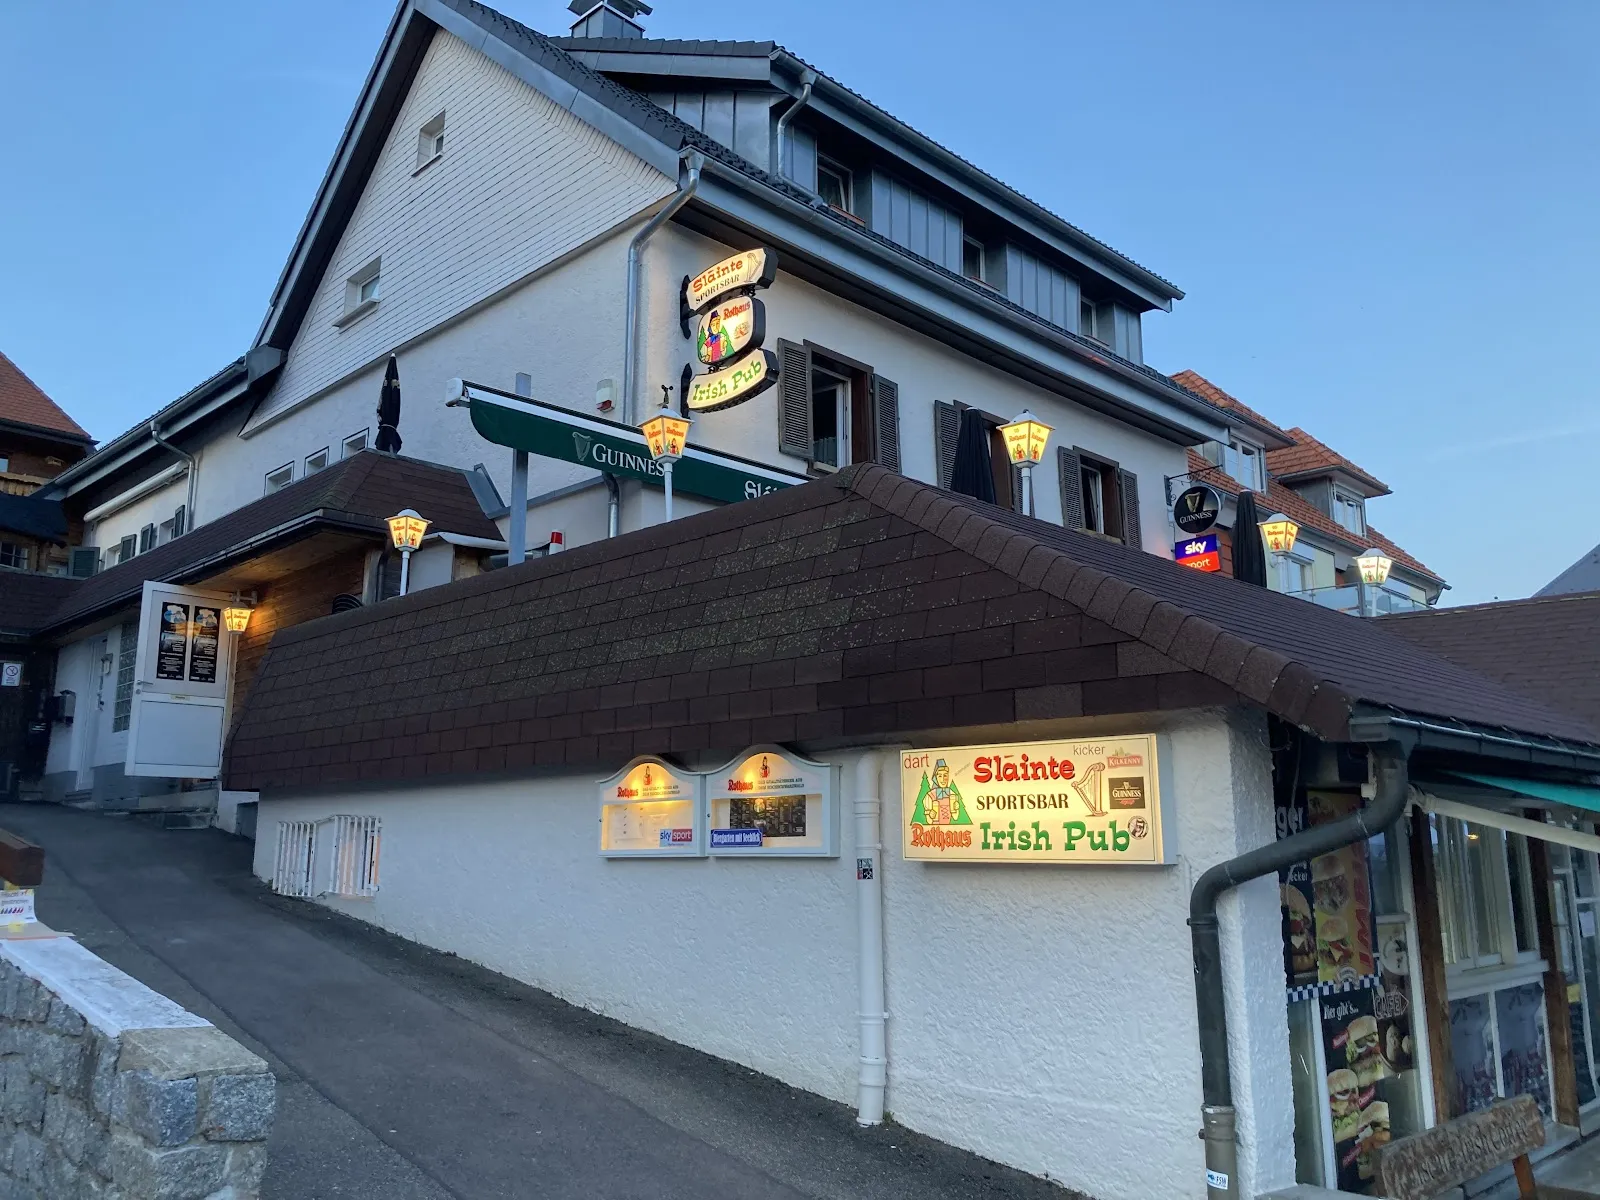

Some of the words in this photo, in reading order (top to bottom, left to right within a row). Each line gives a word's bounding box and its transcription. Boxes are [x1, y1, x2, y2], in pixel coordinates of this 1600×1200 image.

[695, 274, 740, 305] SPORTSBAR
[722, 301, 751, 321] Rothaus
[692, 381, 728, 402] Irish
[731, 360, 762, 392] Pub
[592, 443, 665, 477] GUINNES
[1179, 511, 1213, 524] GUINNESS
[1184, 540, 1207, 555] sky
[1072, 744, 1106, 756] kicker
[904, 753, 930, 769] dart
[1109, 757, 1141, 768] KILKENNY
[727, 779, 754, 792] Rothaus
[1112, 789, 1142, 798] GUINNESS
[976, 793, 1070, 811] SPORTSBAR
[660, 830, 672, 842] sky
[673, 831, 692, 842] sport
[911, 823, 972, 852] Rothaus
[980, 820, 1053, 851] Irish
[1062, 819, 1131, 852] Pub
